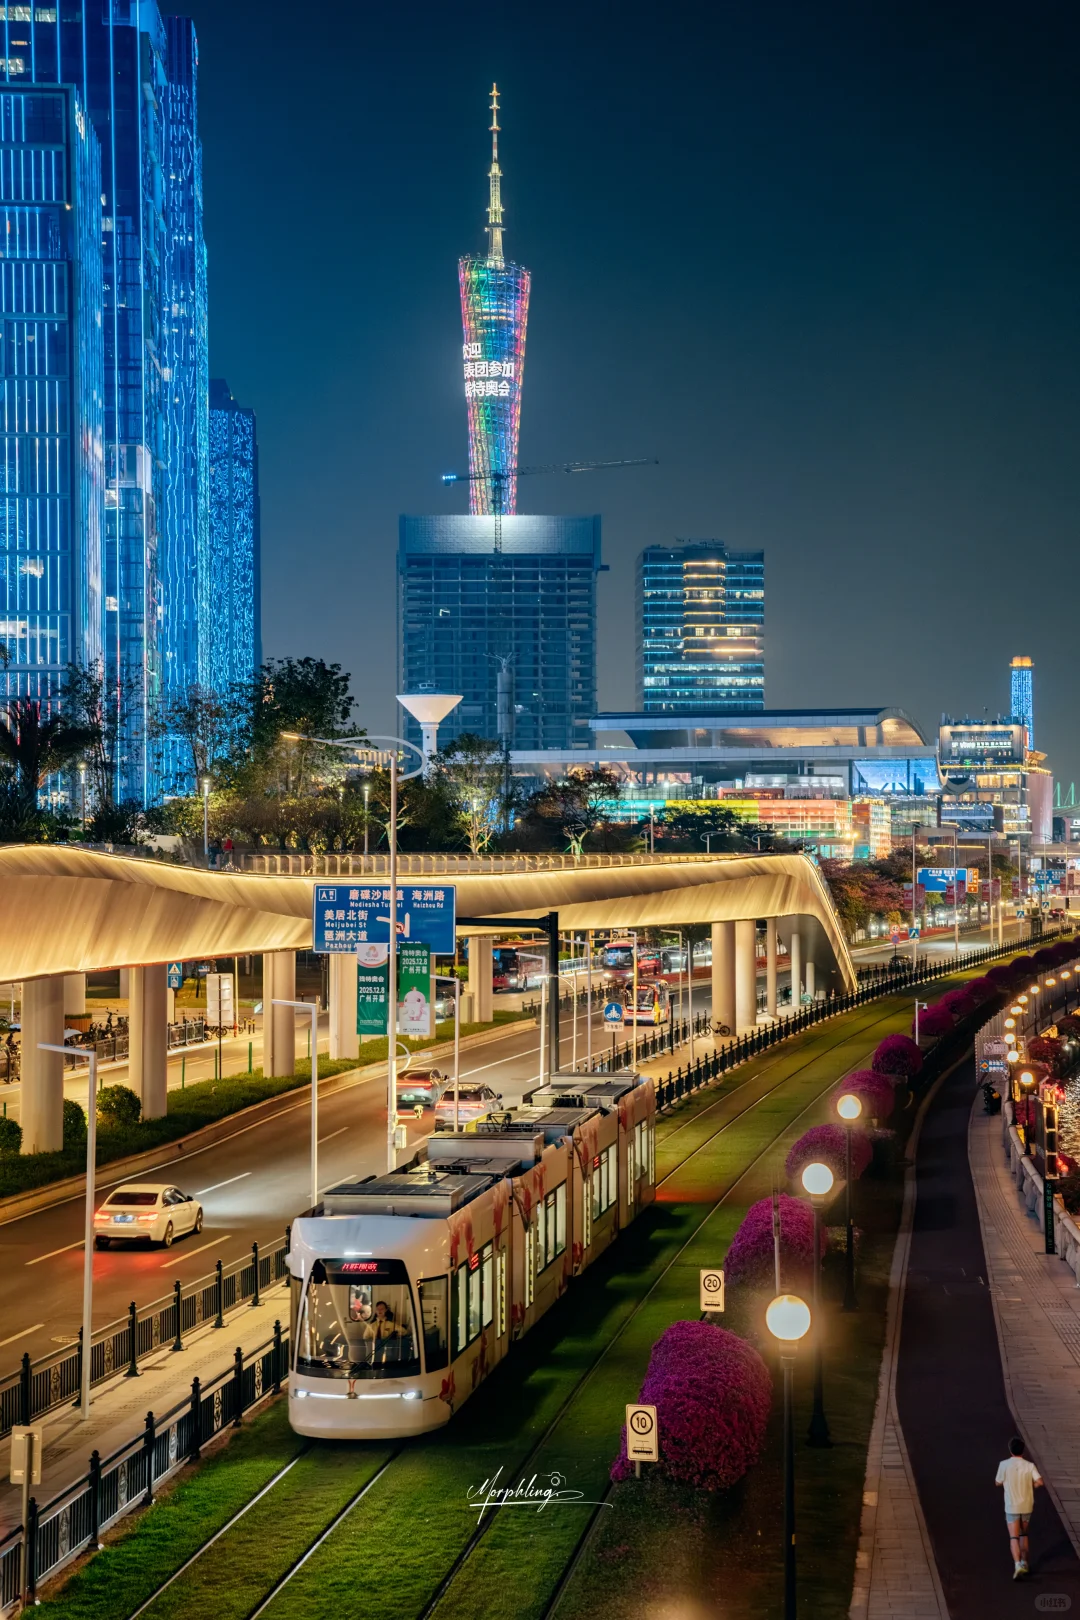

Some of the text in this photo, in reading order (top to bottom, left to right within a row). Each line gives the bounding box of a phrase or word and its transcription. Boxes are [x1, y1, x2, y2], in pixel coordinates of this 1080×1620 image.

[349, 889, 405, 901] 磨碟沙隧道
[411, 889, 445, 901] 海洲路
[324, 909, 369, 921] 美居北街
[325, 921, 357, 929] Meijubei
[324, 930, 368, 942] 琶洲大道
[402, 966, 428, 974] 广州开幕
[359, 986, 385, 994] 2025.12.8
[359, 994, 385, 1003] 广州开幕
[707, 1278, 719, 1288] 20
[636, 1416, 647, 1429] 10
